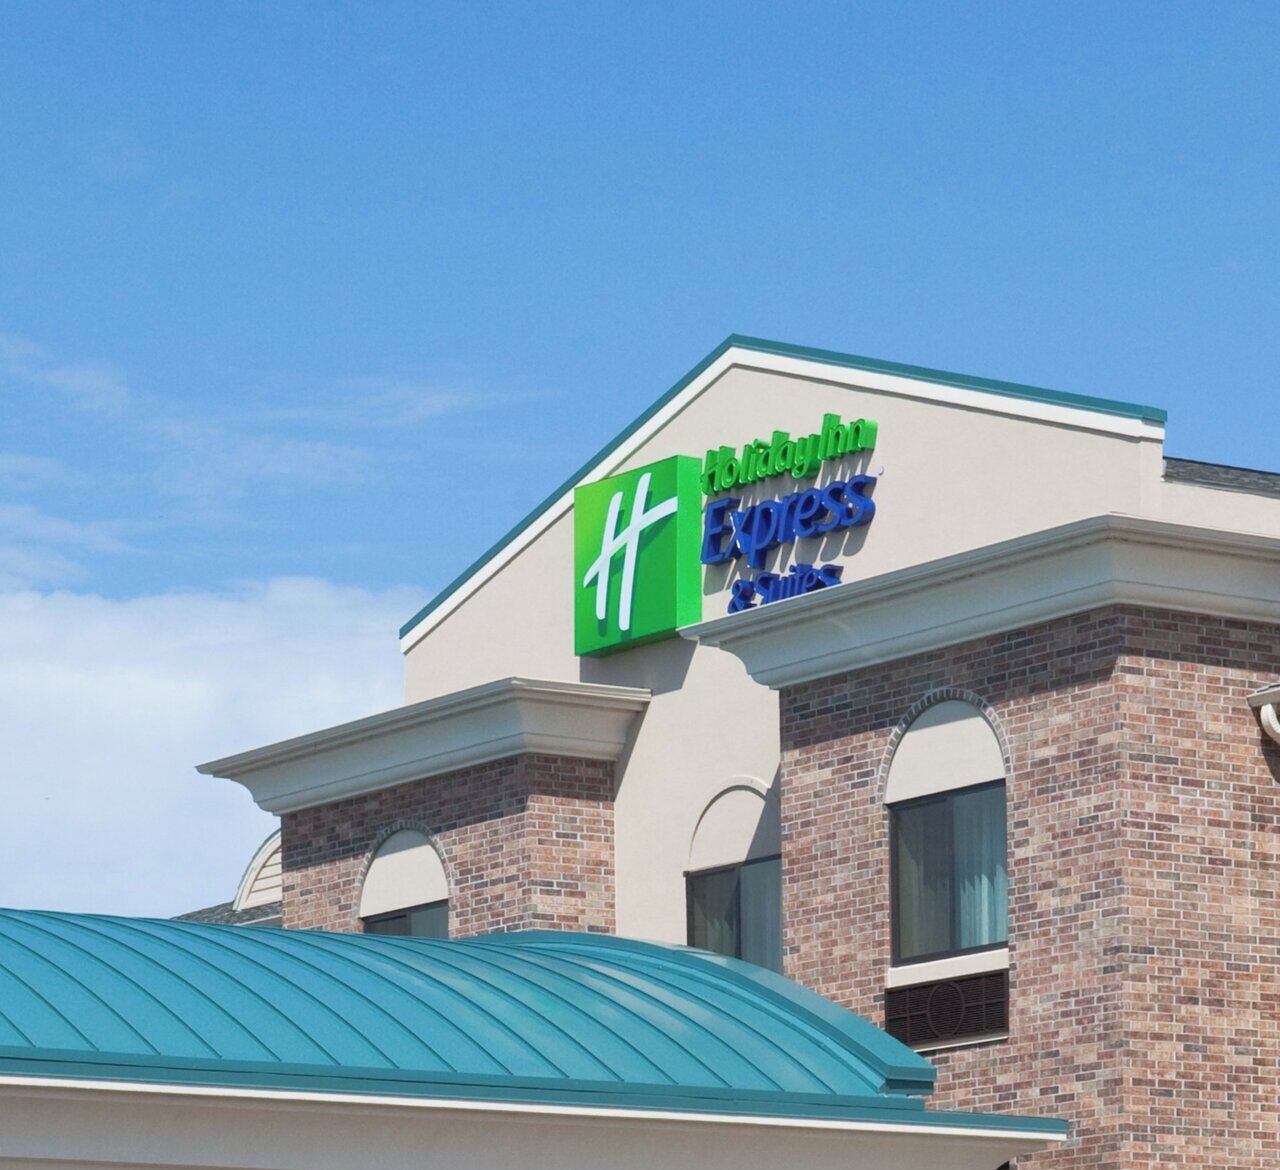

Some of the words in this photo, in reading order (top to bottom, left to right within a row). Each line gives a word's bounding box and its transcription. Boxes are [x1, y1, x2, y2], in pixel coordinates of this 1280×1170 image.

[700, 430, 821, 495] Holiday
[818, 413, 877, 461] Inn
[700, 474, 877, 569] Express
[727, 579, 757, 614] &
[755, 563, 844, 605] Suites
